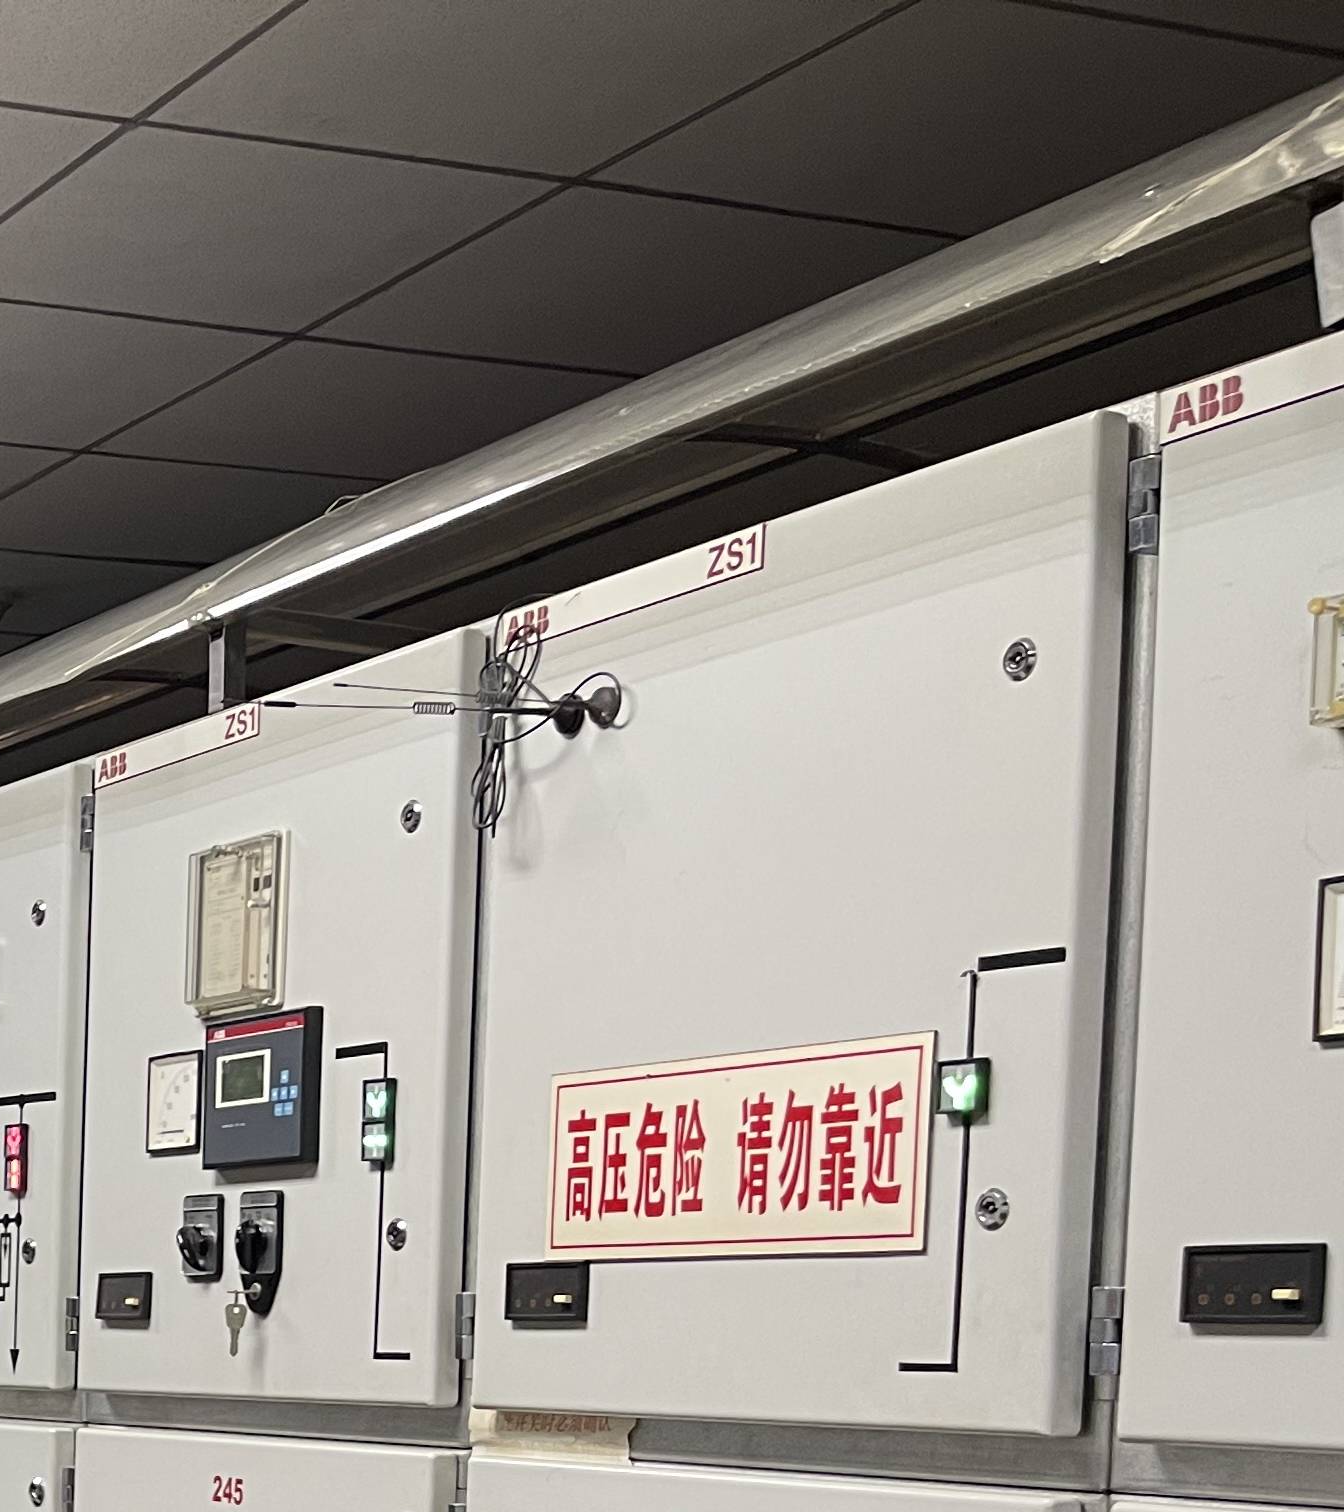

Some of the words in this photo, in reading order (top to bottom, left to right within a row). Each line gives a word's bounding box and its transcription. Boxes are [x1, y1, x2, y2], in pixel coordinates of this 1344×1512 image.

[1168, 375, 1245, 433] ABB
[705, 531, 758, 579] ZS1
[98, 751, 129, 784] ABB
[224, 706, 258, 742] ZS1
[565, 1101, 707, 1224] 高压危险
[735, 1083, 905, 1216] 请勿靠近
[211, 1474, 244, 1506] 245
